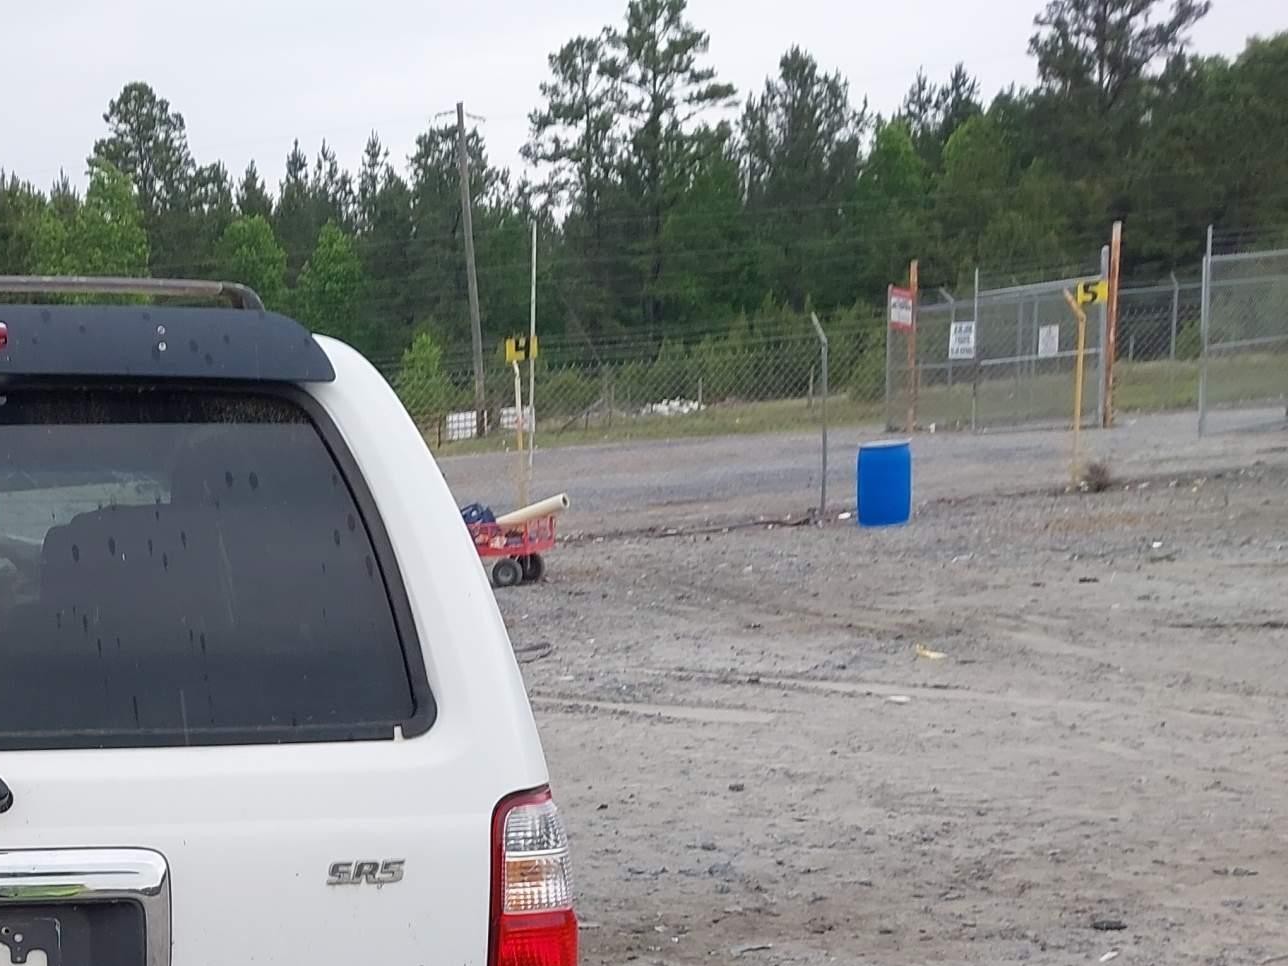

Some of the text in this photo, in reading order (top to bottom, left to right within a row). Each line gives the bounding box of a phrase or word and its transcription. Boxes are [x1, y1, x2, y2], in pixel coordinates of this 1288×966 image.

[1082, 281, 1100, 304] 5
[514, 338, 530, 360] 4
[325, 860, 406, 886] SR5
